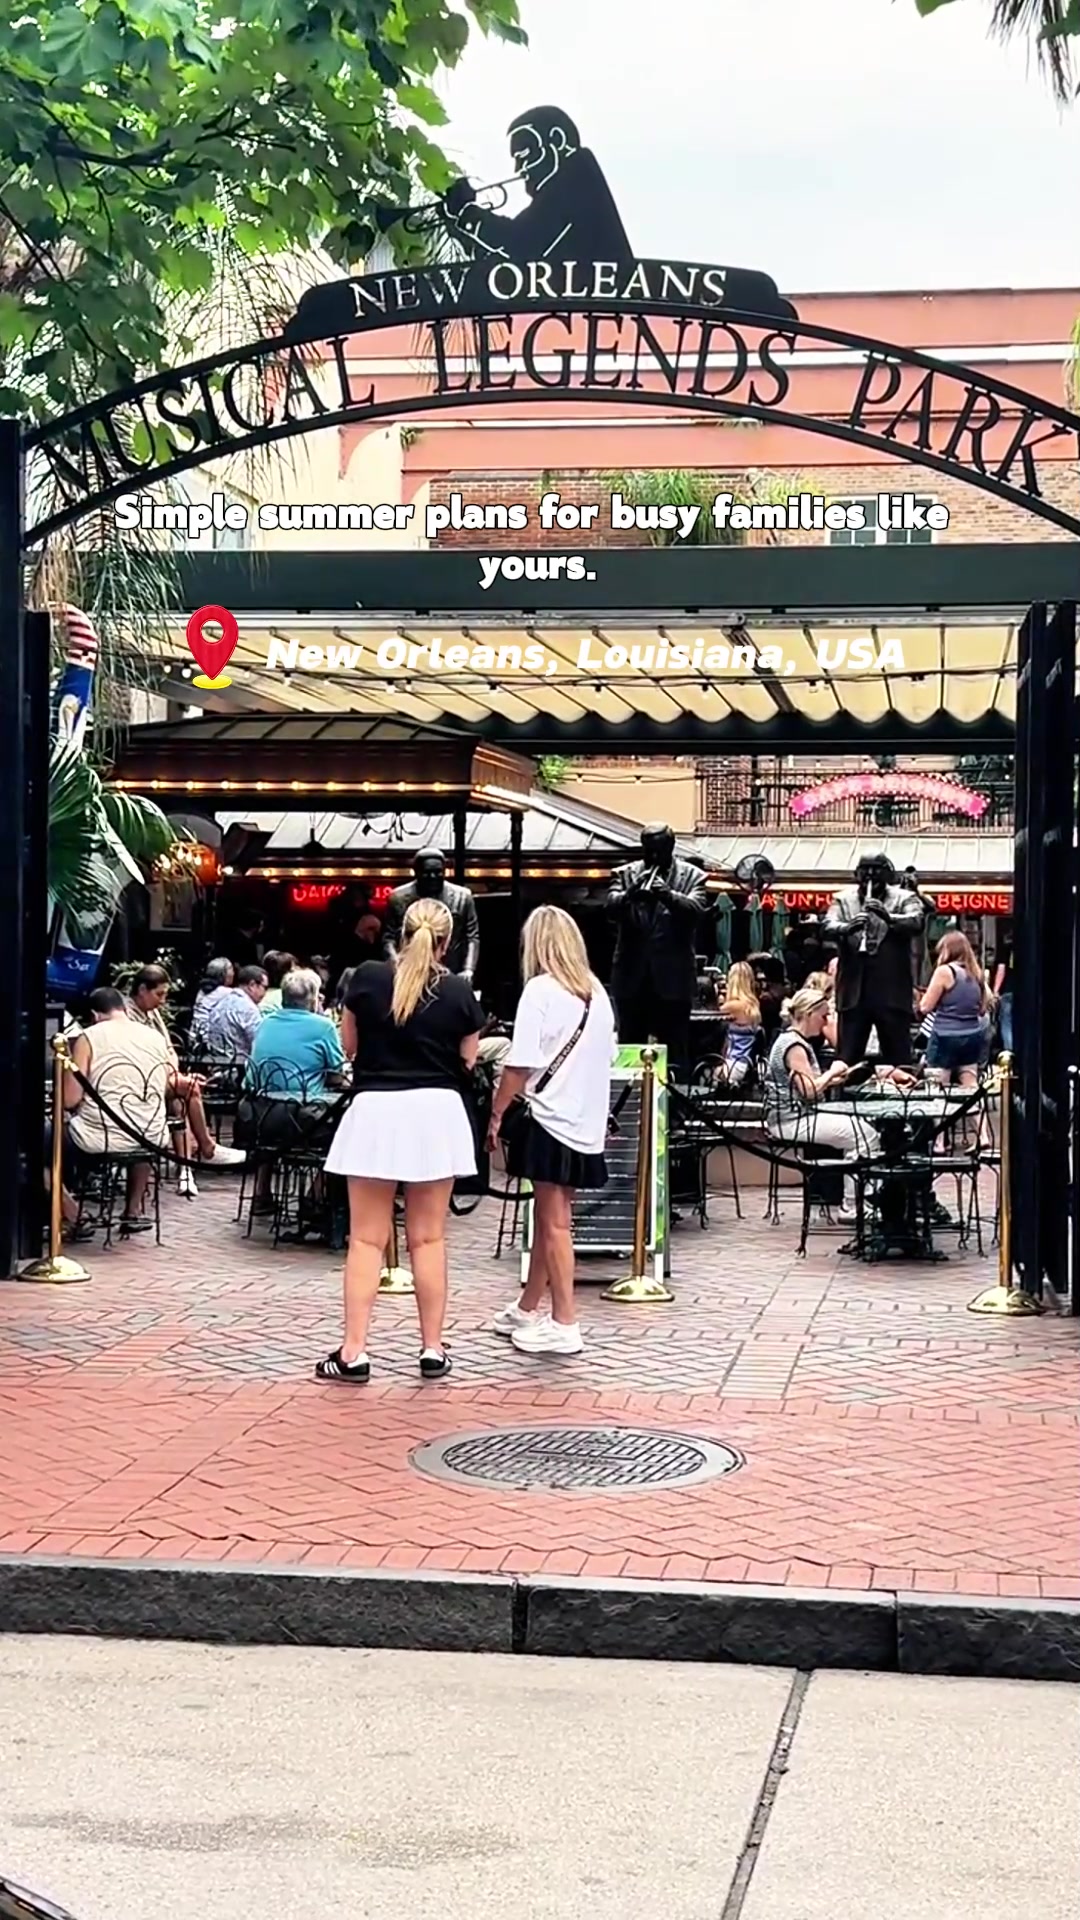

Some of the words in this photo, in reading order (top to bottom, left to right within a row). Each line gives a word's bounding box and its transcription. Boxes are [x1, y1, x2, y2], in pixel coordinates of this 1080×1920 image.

[349, 266, 472, 318] NEW
[487, 261, 728, 307] ORLEANS
[36, 336, 375, 506] MUSICAL
[428, 312, 797, 406] LEGENDS
[845, 352, 1073, 498] PARK
[937, 893, 1009, 909] BEIGNE
